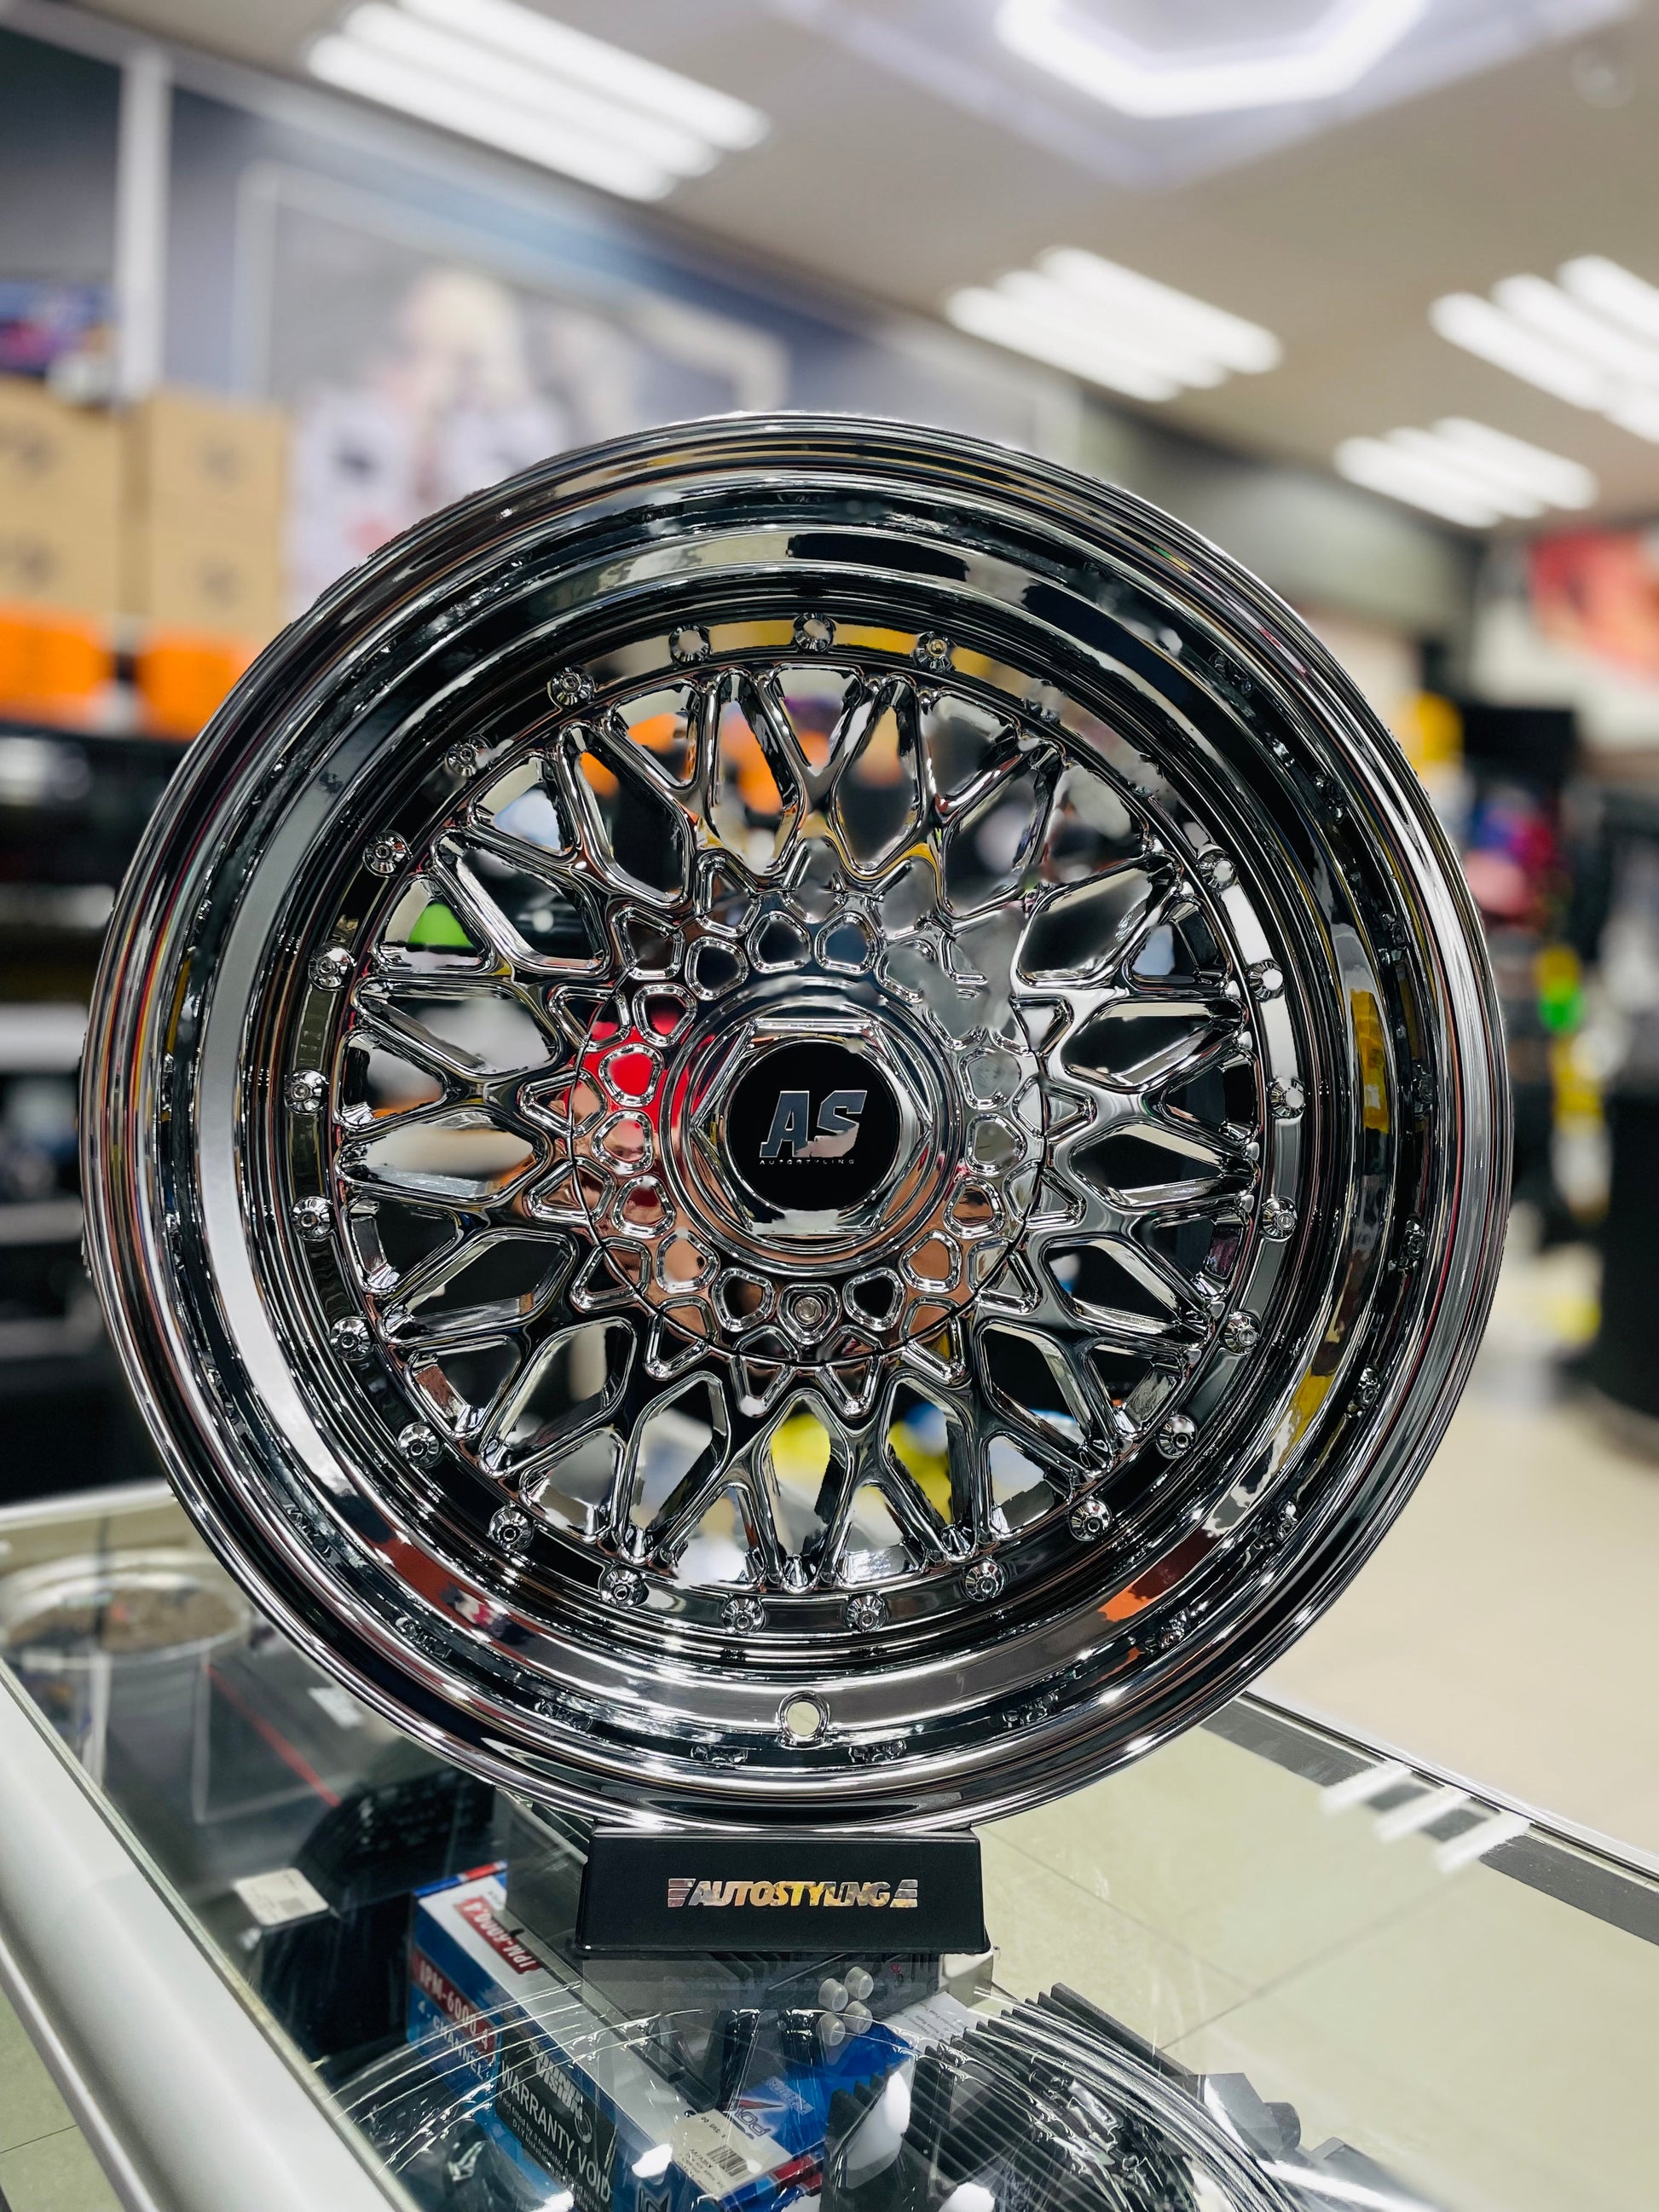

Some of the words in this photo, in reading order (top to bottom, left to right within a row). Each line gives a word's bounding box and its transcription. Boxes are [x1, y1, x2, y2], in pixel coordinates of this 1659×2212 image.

[759, 1089, 868, 1158] AS
[687, 1880, 891, 1907] AUTOSTYLING
[501, 2059, 575, 2160] WARRANTY
[577, 2146, 611, 2203] VOID
